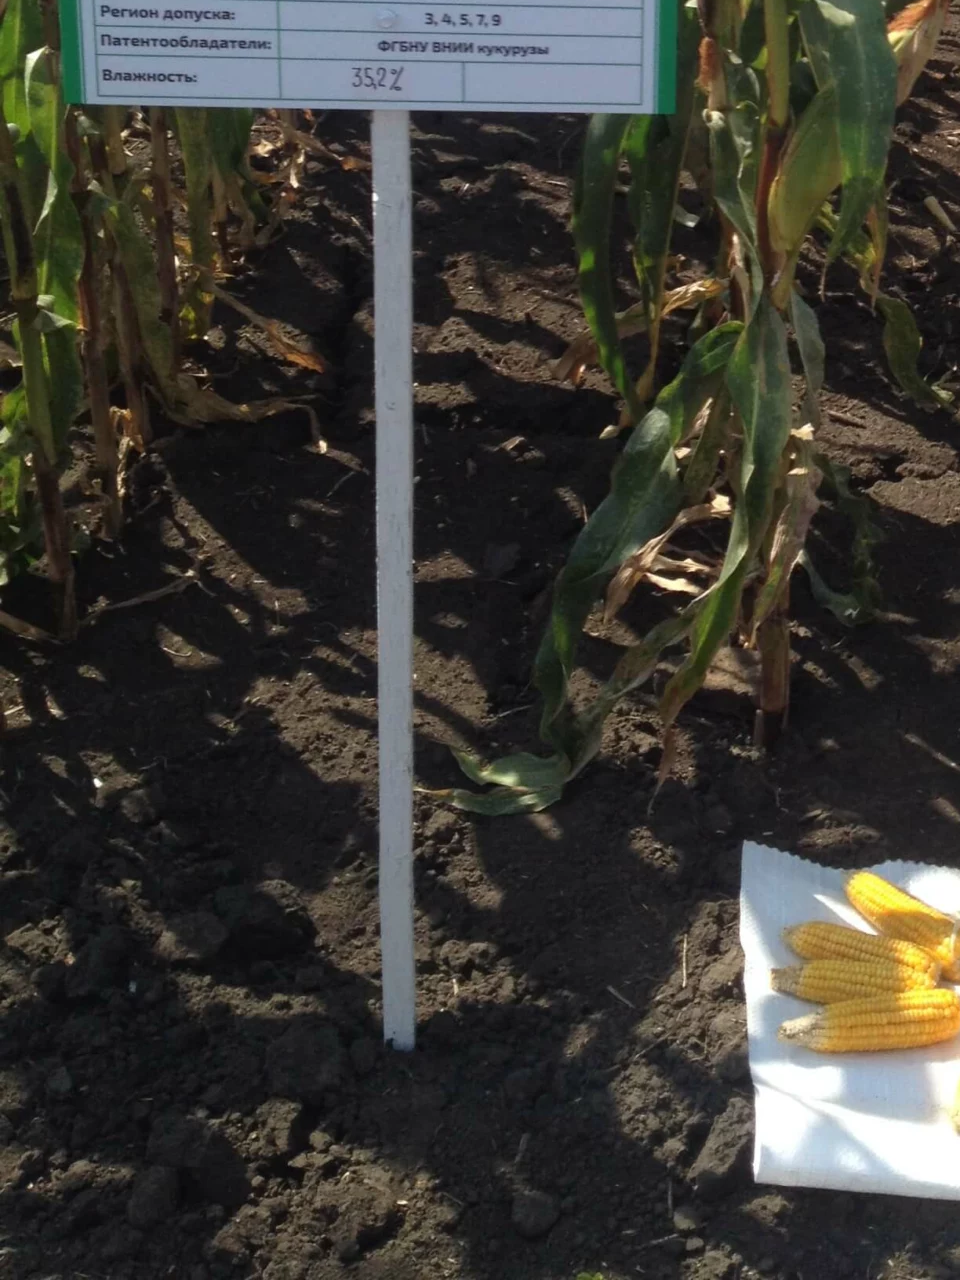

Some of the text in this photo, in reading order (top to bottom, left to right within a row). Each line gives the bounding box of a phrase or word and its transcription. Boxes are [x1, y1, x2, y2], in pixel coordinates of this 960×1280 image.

[100, 5, 236, 23] Регион допуска:
[100, 34, 272, 51] Патентообладатели:
[377, 40, 550, 57] ФГБНУ ВНИИ кукурузы
[102, 69, 198, 83] Влажность:
